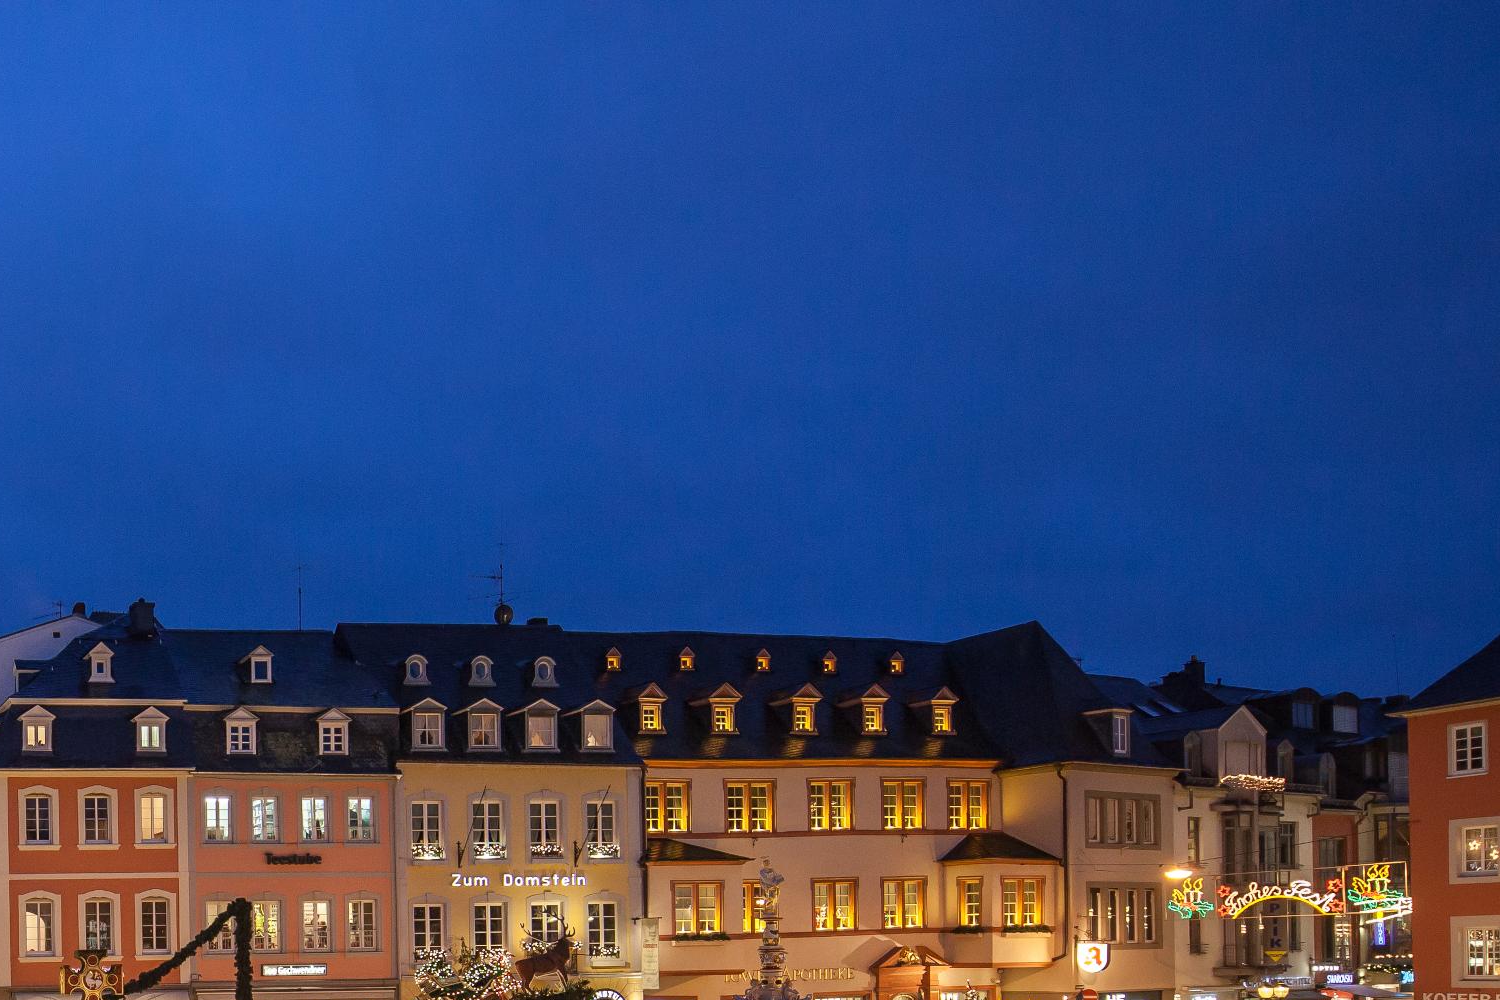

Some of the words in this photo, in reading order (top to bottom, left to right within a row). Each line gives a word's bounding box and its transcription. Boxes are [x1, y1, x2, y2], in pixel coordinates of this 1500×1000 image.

[265, 852, 322, 865] Teestube
[451, 873, 489, 887] Zum
[503, 872, 587, 887] Domstein
[1225, 882, 1282, 915] Frohes
[1284, 880, 1336, 912] Fest
[782, 966, 856, 981] APOTHEKE
